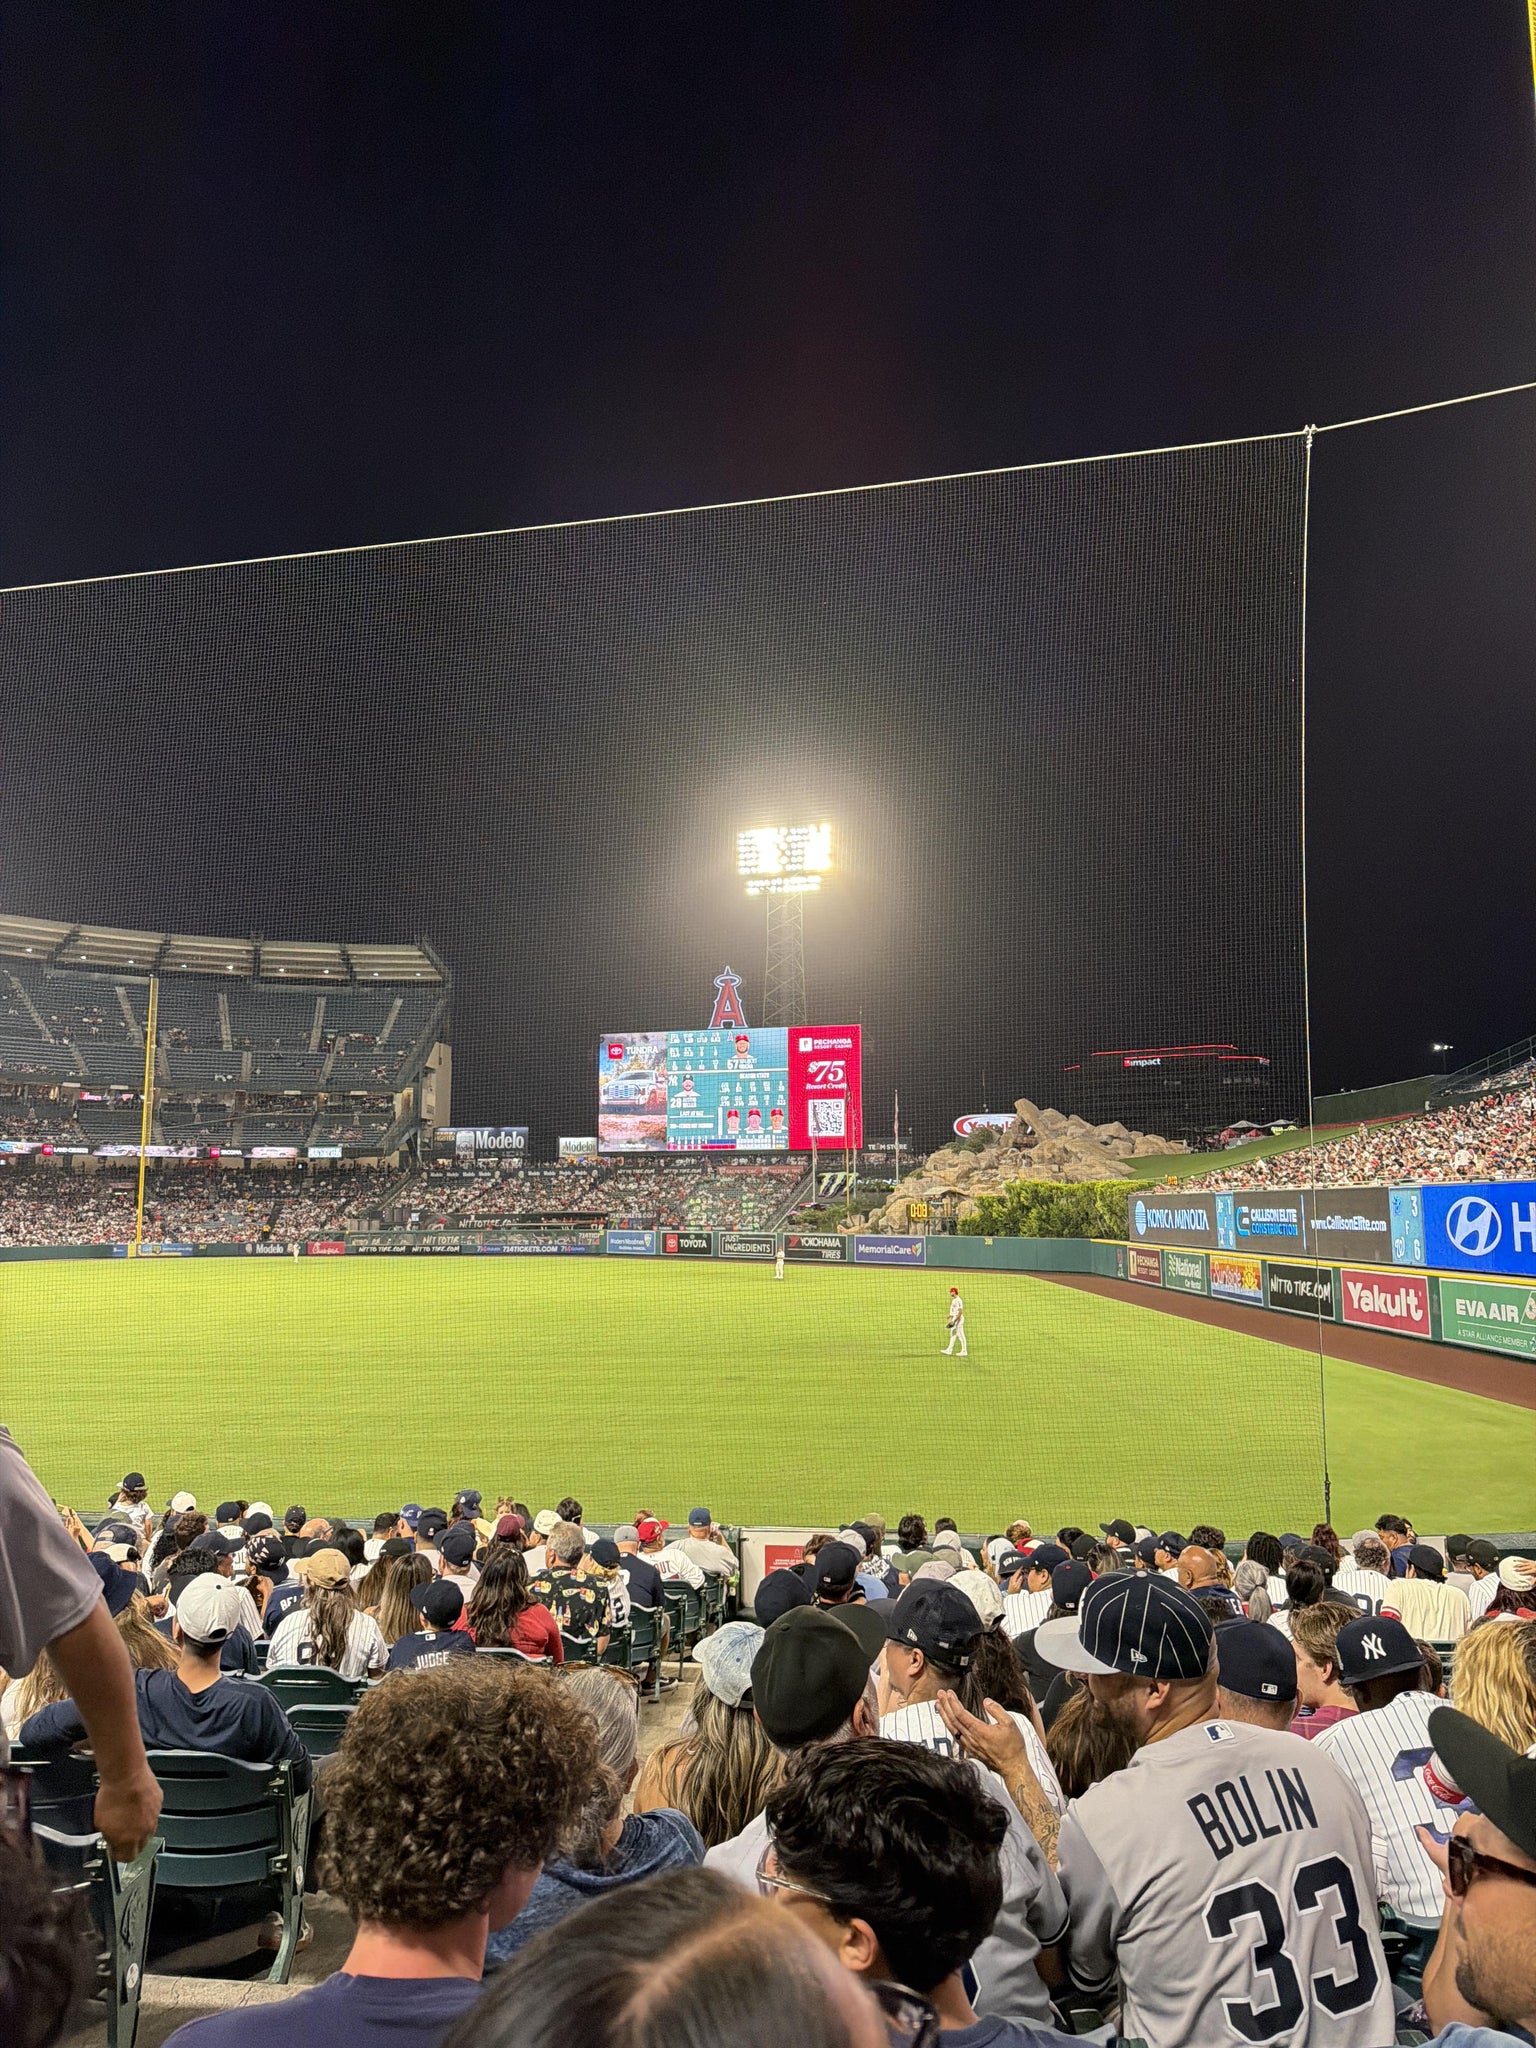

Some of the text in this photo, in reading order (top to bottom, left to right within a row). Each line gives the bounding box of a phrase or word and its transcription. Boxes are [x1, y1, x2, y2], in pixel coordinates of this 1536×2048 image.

[626, 1046, 658, 1055] TUNDRA
[808, 1060, 845, 1082] $75
[1130, 1058, 1161, 1067] impact
[475, 1131, 524, 1149] Modelo
[564, 1140, 593, 1152] Modelo
[1410, 1195, 1418, 1217] 3
[1146, 1209, 1210, 1231] KONICA MINOLTA
[1251, 1208, 1297, 1222] CALLISON ELITE
[1311, 1215, 1387, 1232] www.CallisonElite.com
[1251, 1223, 1298, 1237] CONSTRUCTION
[1404, 1220, 1410, 1235] F
[256, 1244, 284, 1254] Modelo
[680, 1239, 707, 1249] TOYOTA
[725, 1243, 770, 1253] INGREDIENTS
[800, 1237, 842, 1247] YOKOHAMA
[858, 1244, 912, 1255] MemorialCare
[1413, 1239, 1421, 1261] 6
[821, 1250, 841, 1259] TIRES
[1137, 1255, 1159, 1268] PECHANGA
[1175, 1257, 1201, 1279] National
[1270, 1274, 1293, 1294] NITTO
[1294, 1279, 1331, 1303] TIRE.COM
[1346, 1281, 1424, 1322] Yakult
[1462, 1329, 1475, 1339] STAR
[1476, 1331, 1502, 1343] ALLIANCE
[1502, 1334, 1528, 1347] MEMBER
[1360, 1632, 1387, 1660] NY
[415, 1651, 450, 1671] JUDGE
[1186, 1767, 1319, 1862] BOLIN
[1201, 1850, 1380, 2047] 33
